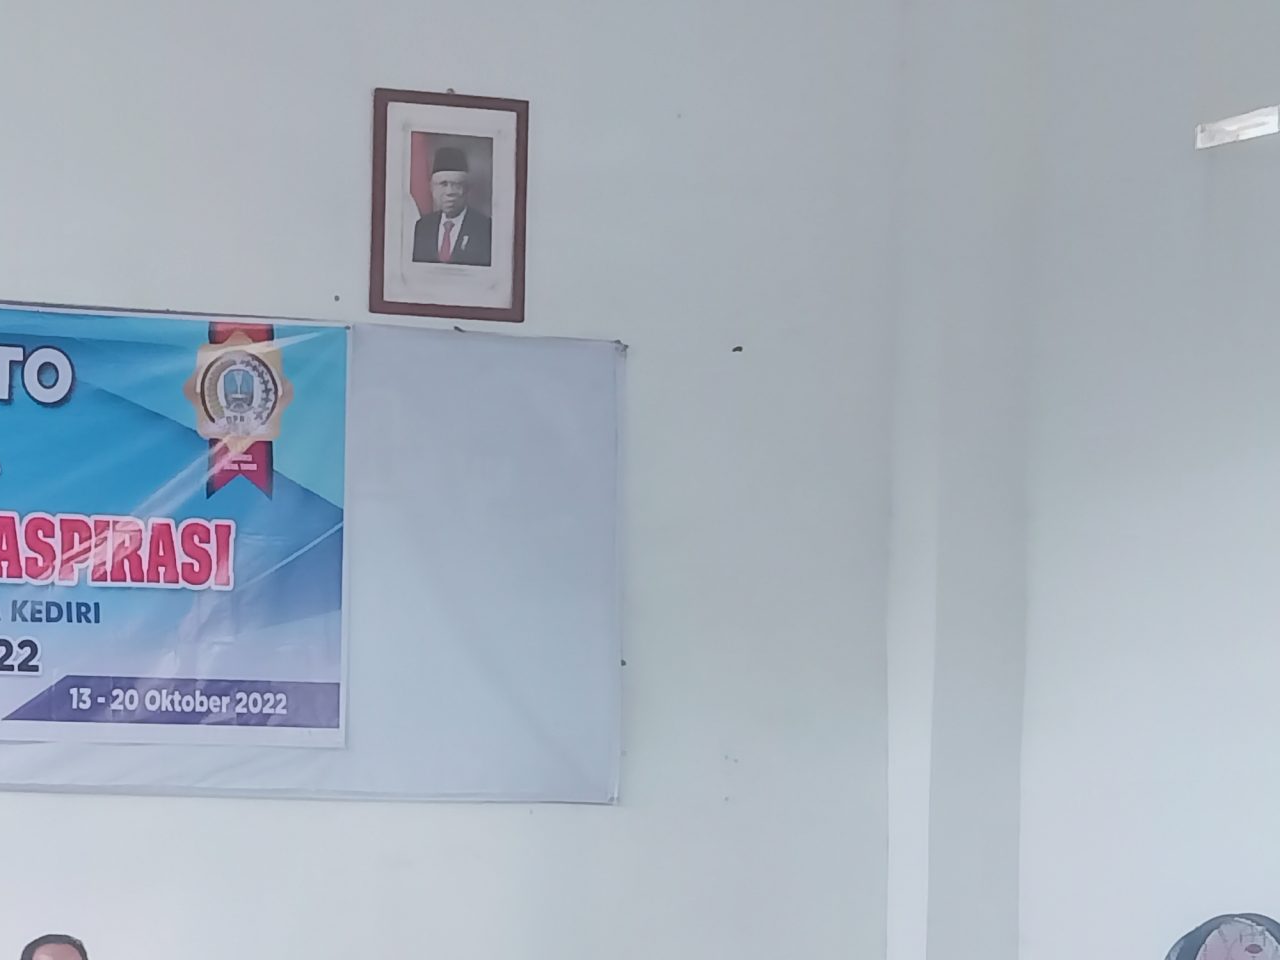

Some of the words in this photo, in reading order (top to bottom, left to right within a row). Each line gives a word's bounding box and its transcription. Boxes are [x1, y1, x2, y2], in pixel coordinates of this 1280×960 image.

[11, 600, 100, 624] KEDIRI
[69, 687, 92, 710] 13
[111, 689, 139, 712] 20
[145, 689, 230, 713] Oktober
[235, 692, 288, 715] 2022
